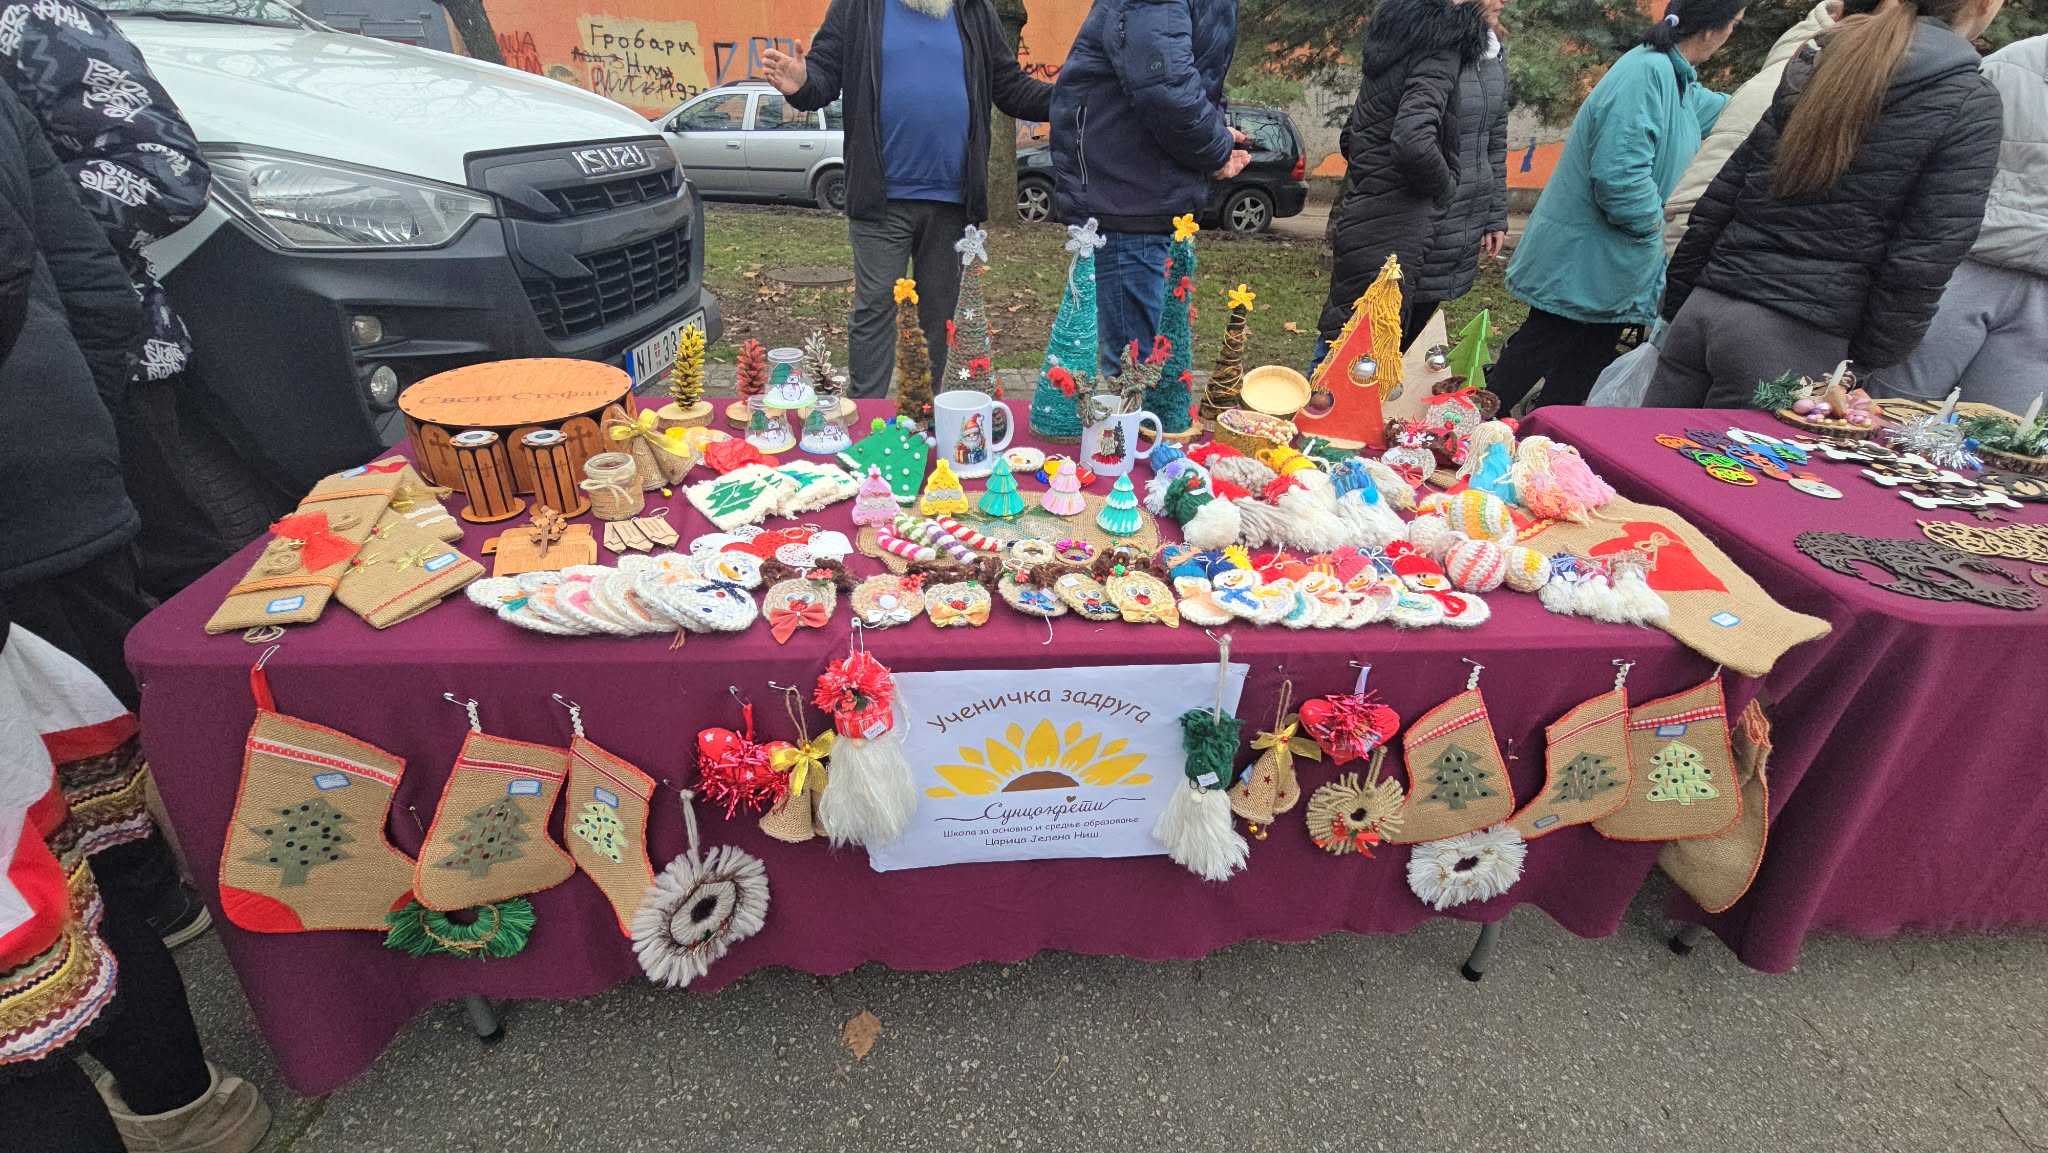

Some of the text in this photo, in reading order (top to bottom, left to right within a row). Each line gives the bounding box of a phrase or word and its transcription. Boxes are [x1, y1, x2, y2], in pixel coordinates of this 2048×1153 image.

[590, 24, 696, 56] Гробари
[571, 145, 647, 175] ISUZU
[637, 345, 652, 379] NI
[419, 389, 608, 405] Свети Стефан
[926, 689, 1051, 733] Ученичка
[1060, 689, 1151, 724] задруга
[980, 800, 1110, 826] Сунцокрети
[943, 829, 977, 838] Школа
[992, 825, 1033, 834] основно
[1045, 821, 1080, 832] средње
[1083, 817, 1140, 828] образовање
[985, 831, 1099, 846] Царица Јелена Ниш
